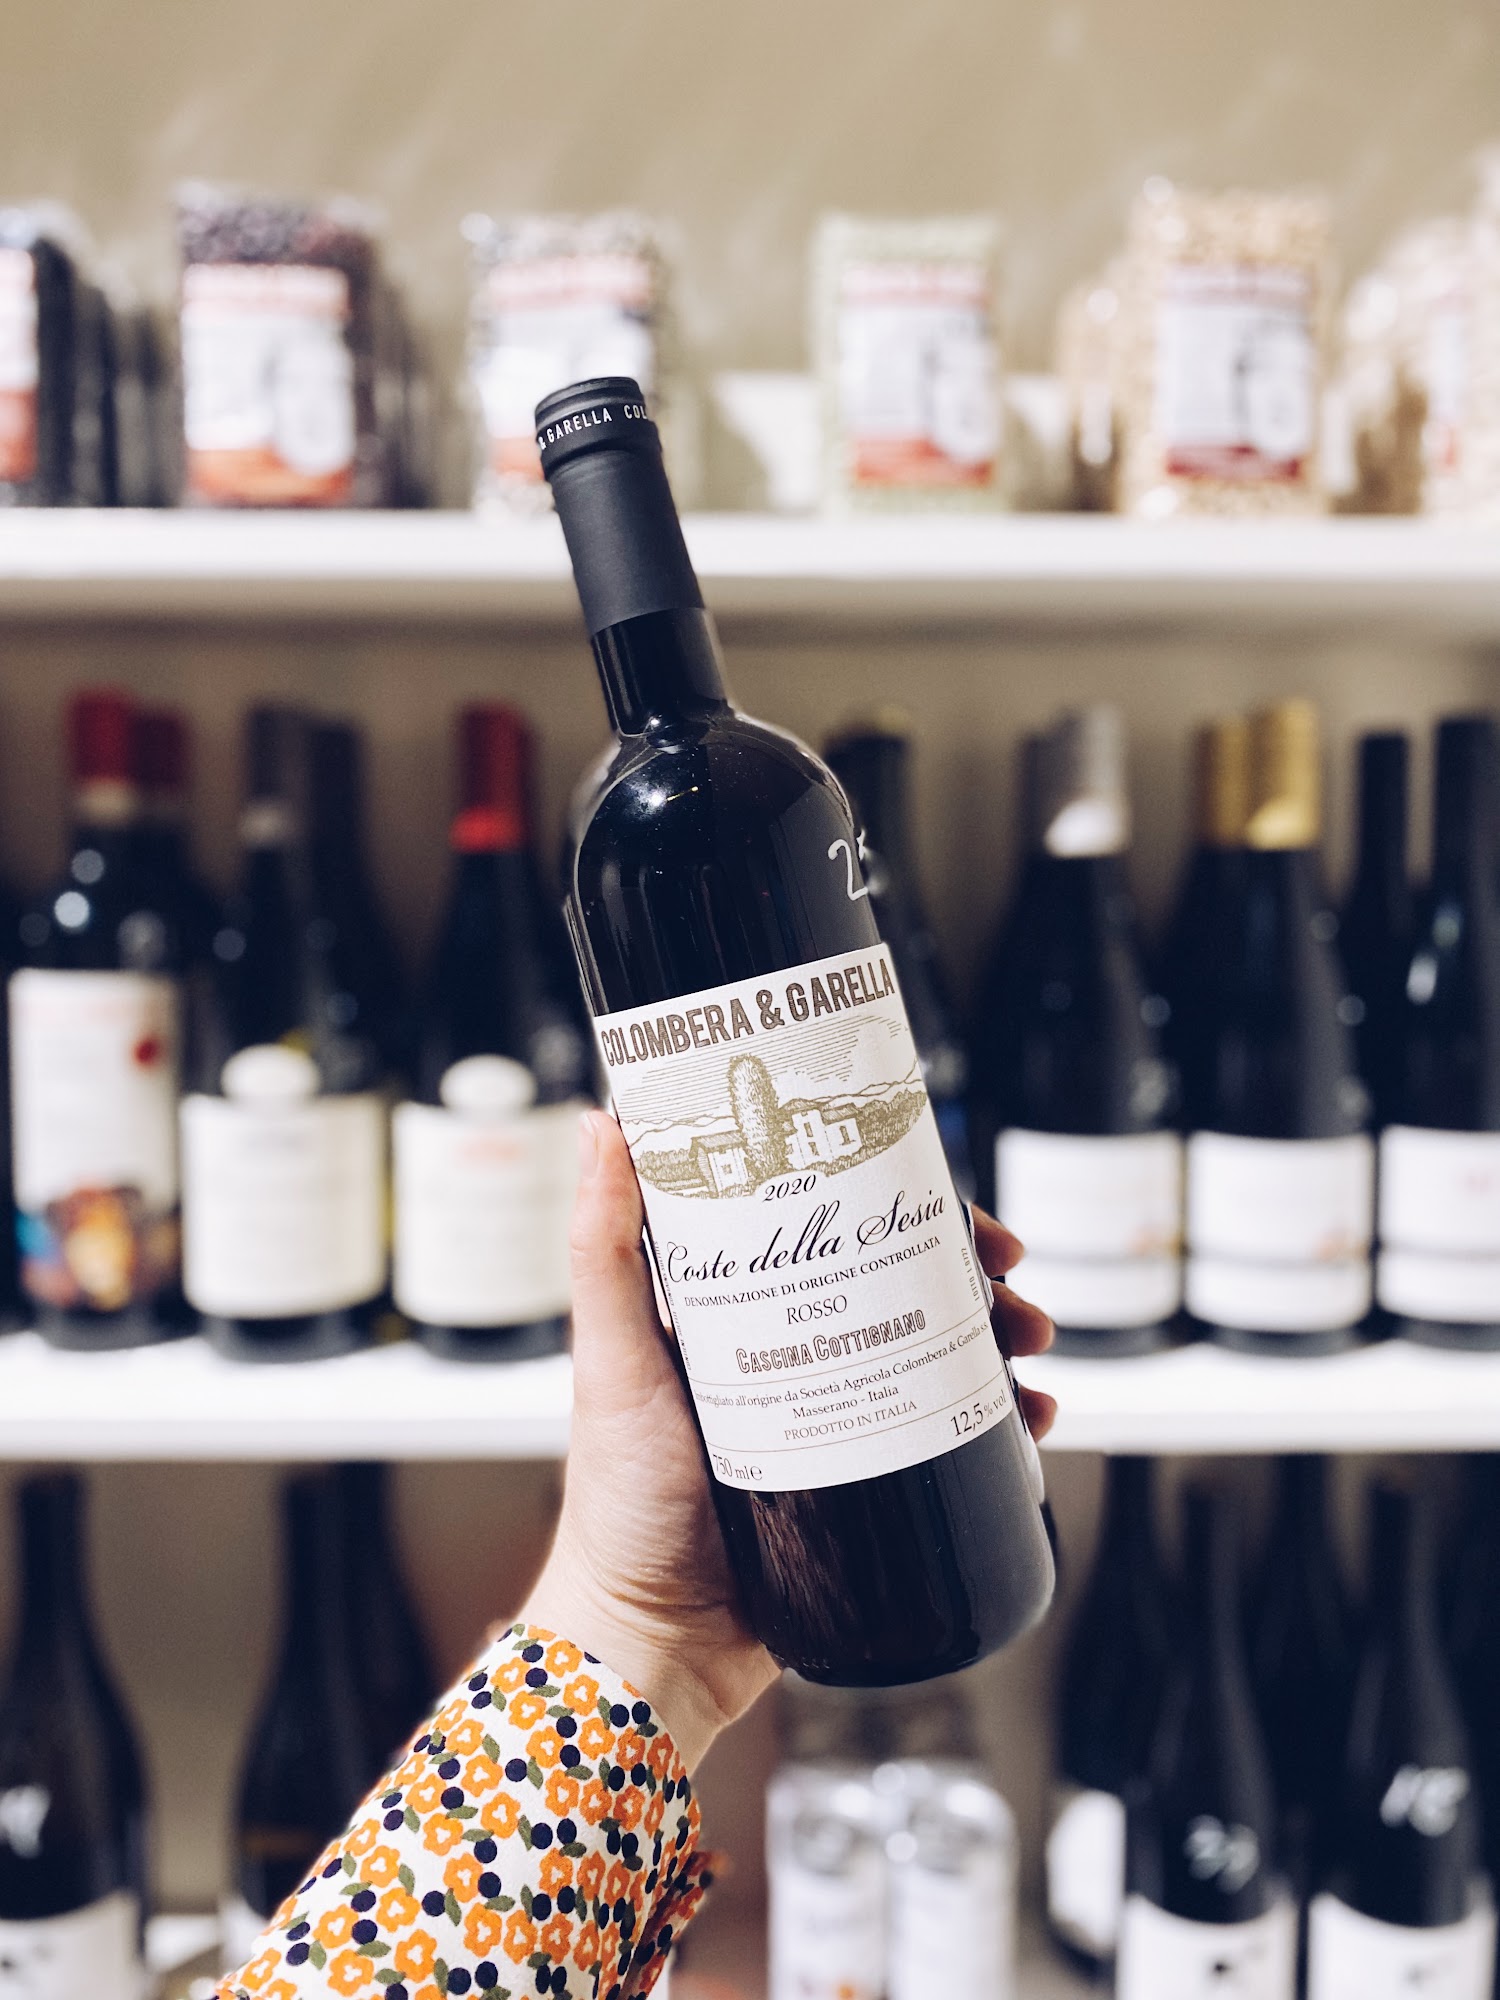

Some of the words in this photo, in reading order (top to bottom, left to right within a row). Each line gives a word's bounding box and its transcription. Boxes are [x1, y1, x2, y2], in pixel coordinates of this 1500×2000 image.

[547, 407, 612, 443] GARELLA
[600, 998, 754, 1067] COLOMBERA
[756, 988, 786, 1031] &
[785, 958, 896, 1022] GARELLA
[762, 1174, 817, 1202] 2020
[666, 1241, 740, 1283] Coste
[749, 1200, 846, 1274] della
[856, 1190, 946, 1255] Sesia
[684, 1286, 778, 1307] DENOMINAZIONE
[780, 1282, 796, 1296] DI
[799, 1267, 858, 1292] ORIGINE
[860, 1236, 941, 1275] CONTROLLATA
[786, 1294, 848, 1325] ROSSO
[735, 1394, 782, 1409] all'origine
[784, 1390, 799, 1402] da
[800, 1381, 842, 1401] Società
[842, 1367, 892, 1391] Agricola
[892, 1345, 949, 1375] Colombera
[948, 1341, 958, 1353] &
[957, 1326, 981, 1347] Garella
[792, 1399, 858, 1419] Masserano
[868, 1386, 899, 1403] Italia
[992, 1389, 1007, 1411] vol
[784, 1419, 854, 1441] PRODOTTO
[857, 1414, 874, 1427] IN
[875, 1400, 917, 1422] ITALIA
[712, 1453, 733, 1478] 750
